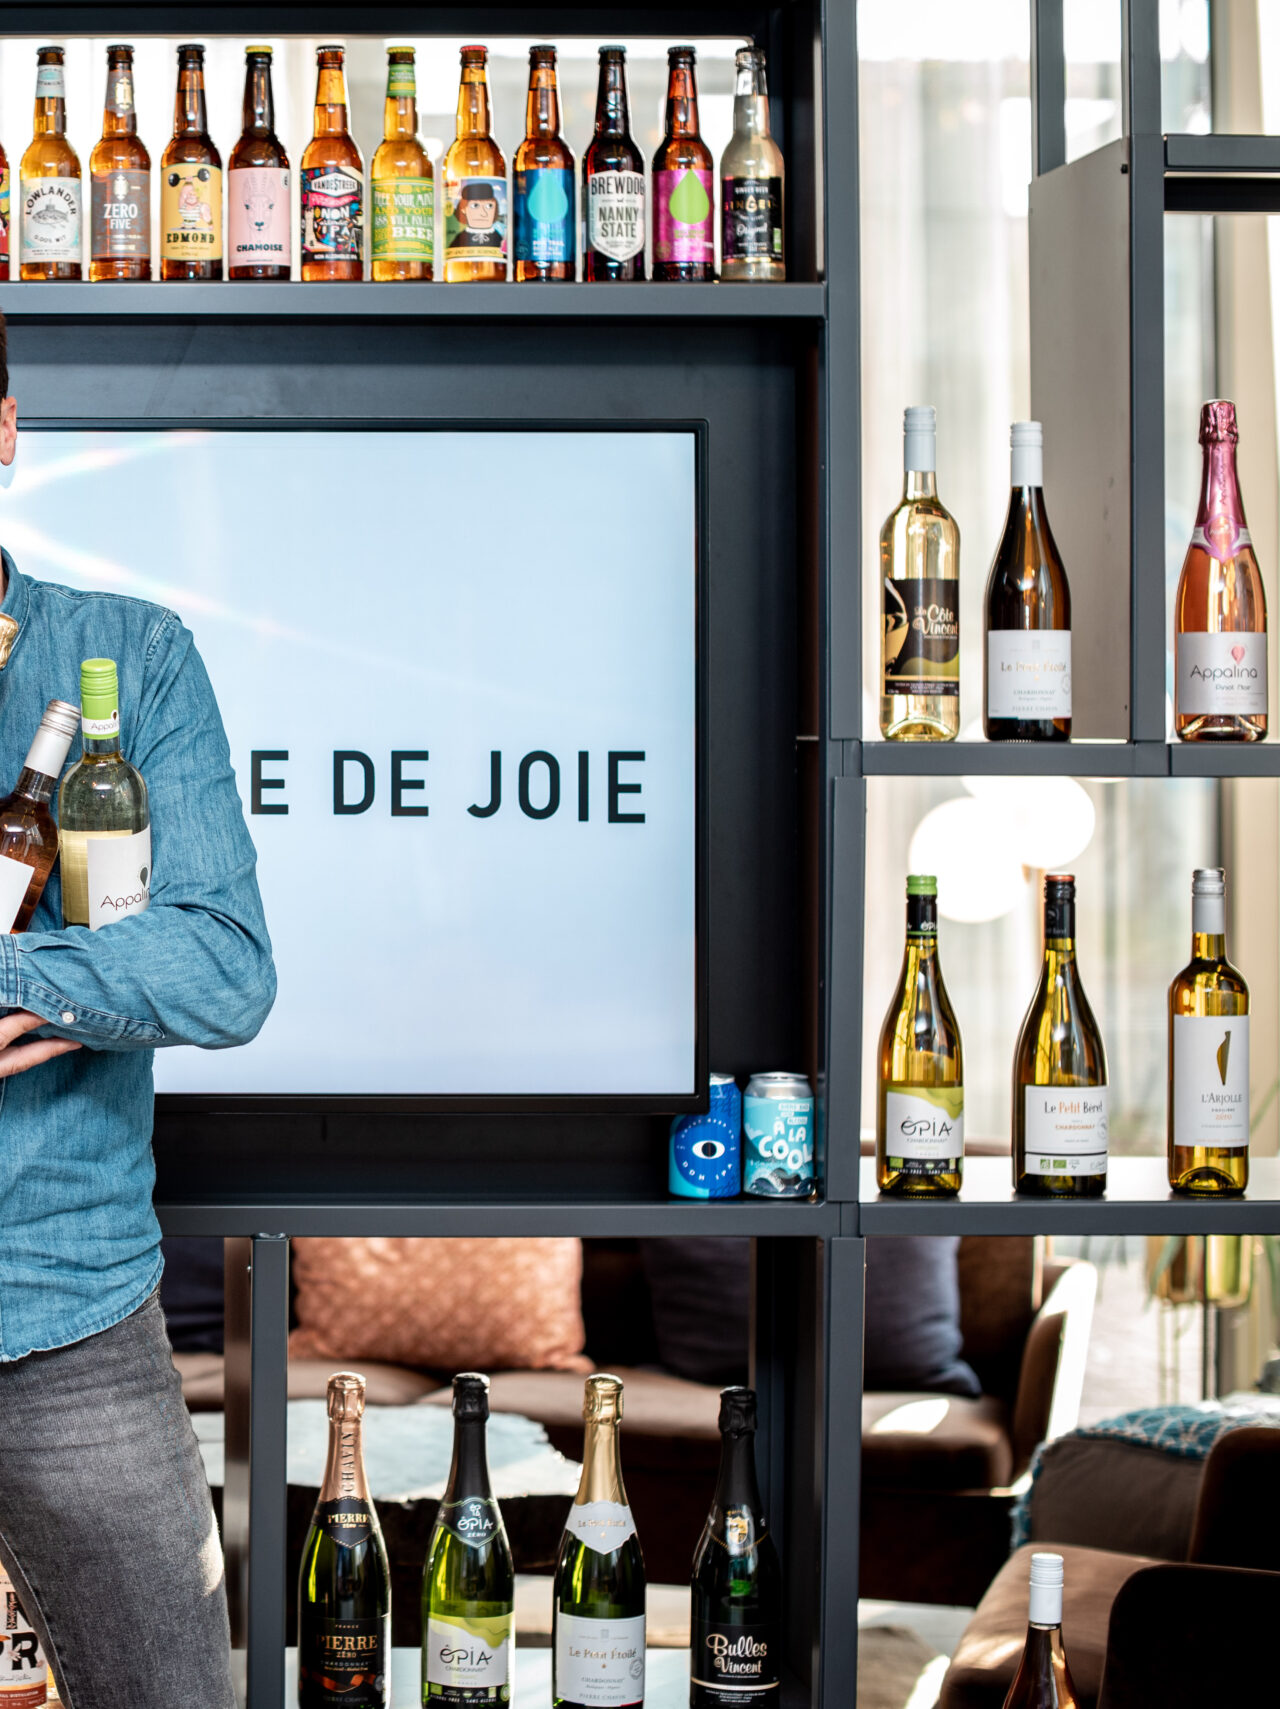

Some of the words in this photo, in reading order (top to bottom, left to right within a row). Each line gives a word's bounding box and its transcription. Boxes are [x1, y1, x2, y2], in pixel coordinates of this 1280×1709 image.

[590, 175, 645, 196] BREWDOG
[25, 185, 77, 216] LOWLANDER
[103, 203, 139, 219] ZERO
[321, 205, 350, 220] NON
[598, 206, 639, 222] NANNY
[110, 219, 131, 230] FIVE
[322, 225, 351, 239] IPA
[601, 222, 637, 238] STATE
[166, 232, 215, 244] EDMOND
[236, 244, 283, 253] CHAMOISE
[1000, 661, 1013, 672] Le
[1190, 664, 1258, 682] Appalina
[333, 750, 429, 817] DE
[466, 750, 646, 824] JOIE
[1201, 1092, 1243, 1105] L'ARJOLLE
[1043, 1101, 1056, 1114] Le
[1058, 1101, 1081, 1114] Petit
[788, 1126, 807, 1143] LA
[758, 1135, 812, 1170] COOL
[714, 1163, 733, 1180] IPA
[341, 1432, 355, 1493] CHAVIN
[568, 1646, 581, 1657] Le
[705, 1633, 768, 1657] Bulles
[717, 1657, 763, 1674] Vincent
